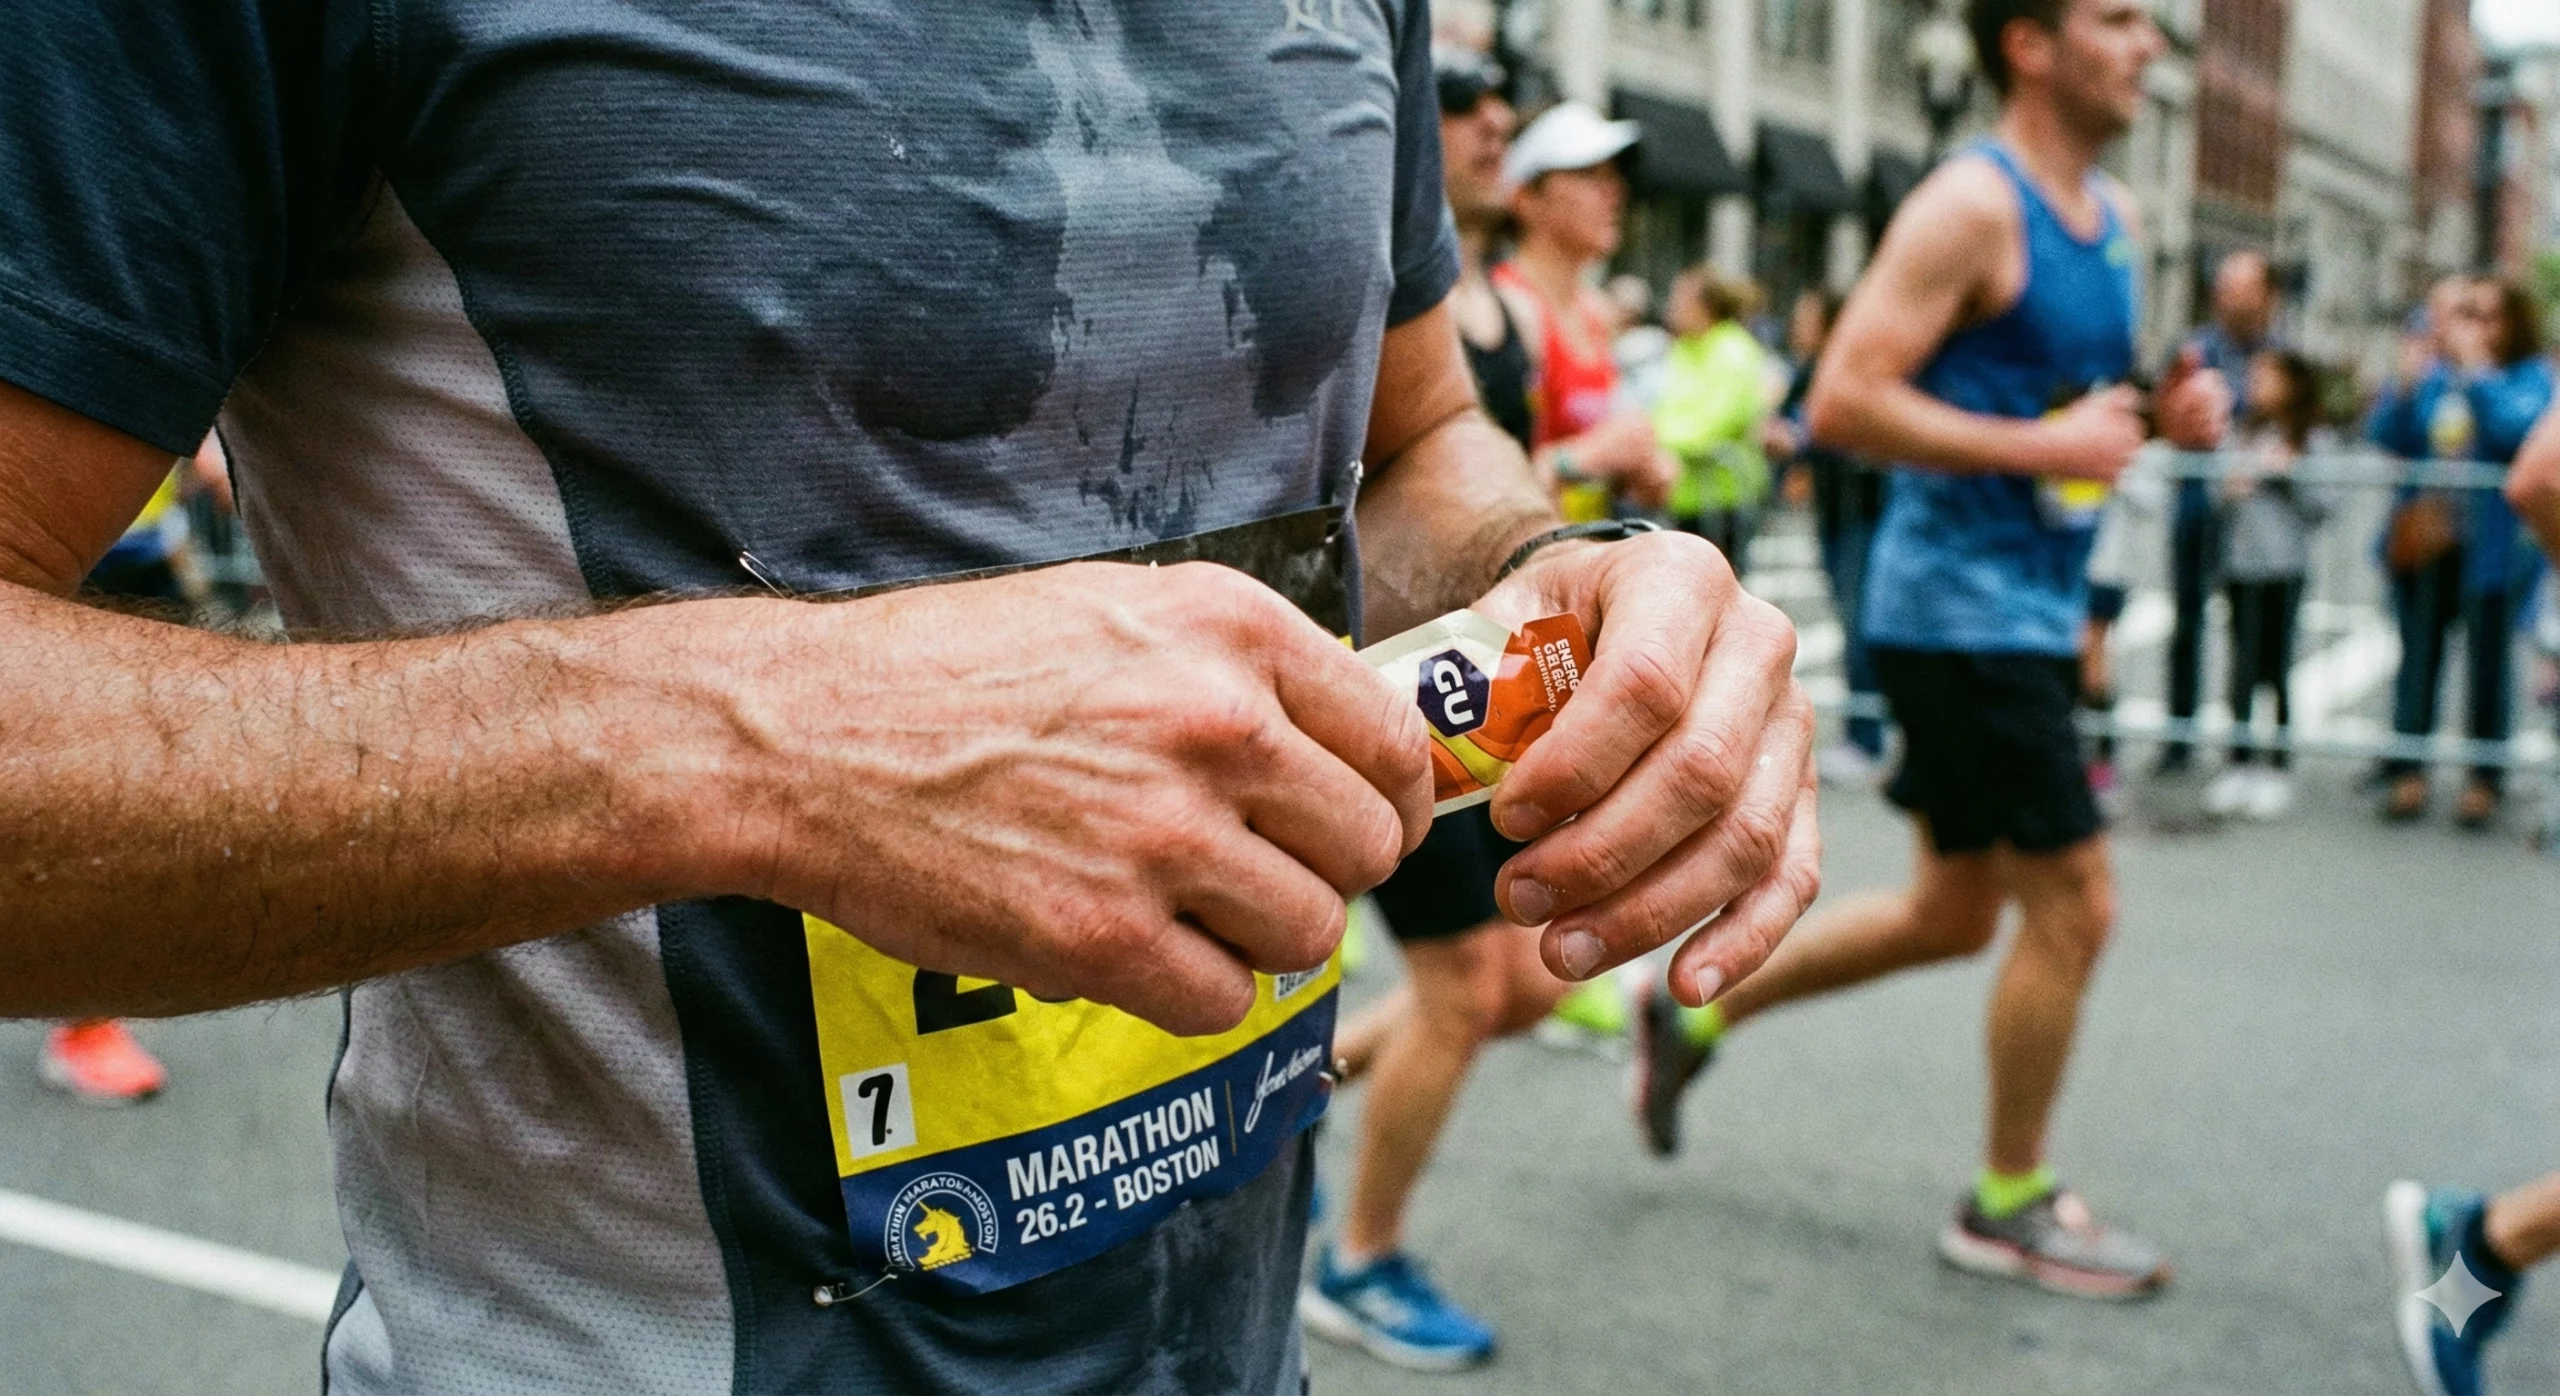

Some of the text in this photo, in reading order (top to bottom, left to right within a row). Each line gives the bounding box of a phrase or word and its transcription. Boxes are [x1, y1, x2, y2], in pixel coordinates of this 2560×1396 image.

[1433, 659, 1475, 725] GU
[1006, 1087, 1216, 1201] MARATHON
[1016, 1192, 1088, 1245] 26.2
[1113, 1135, 1220, 1211] BOSTON
